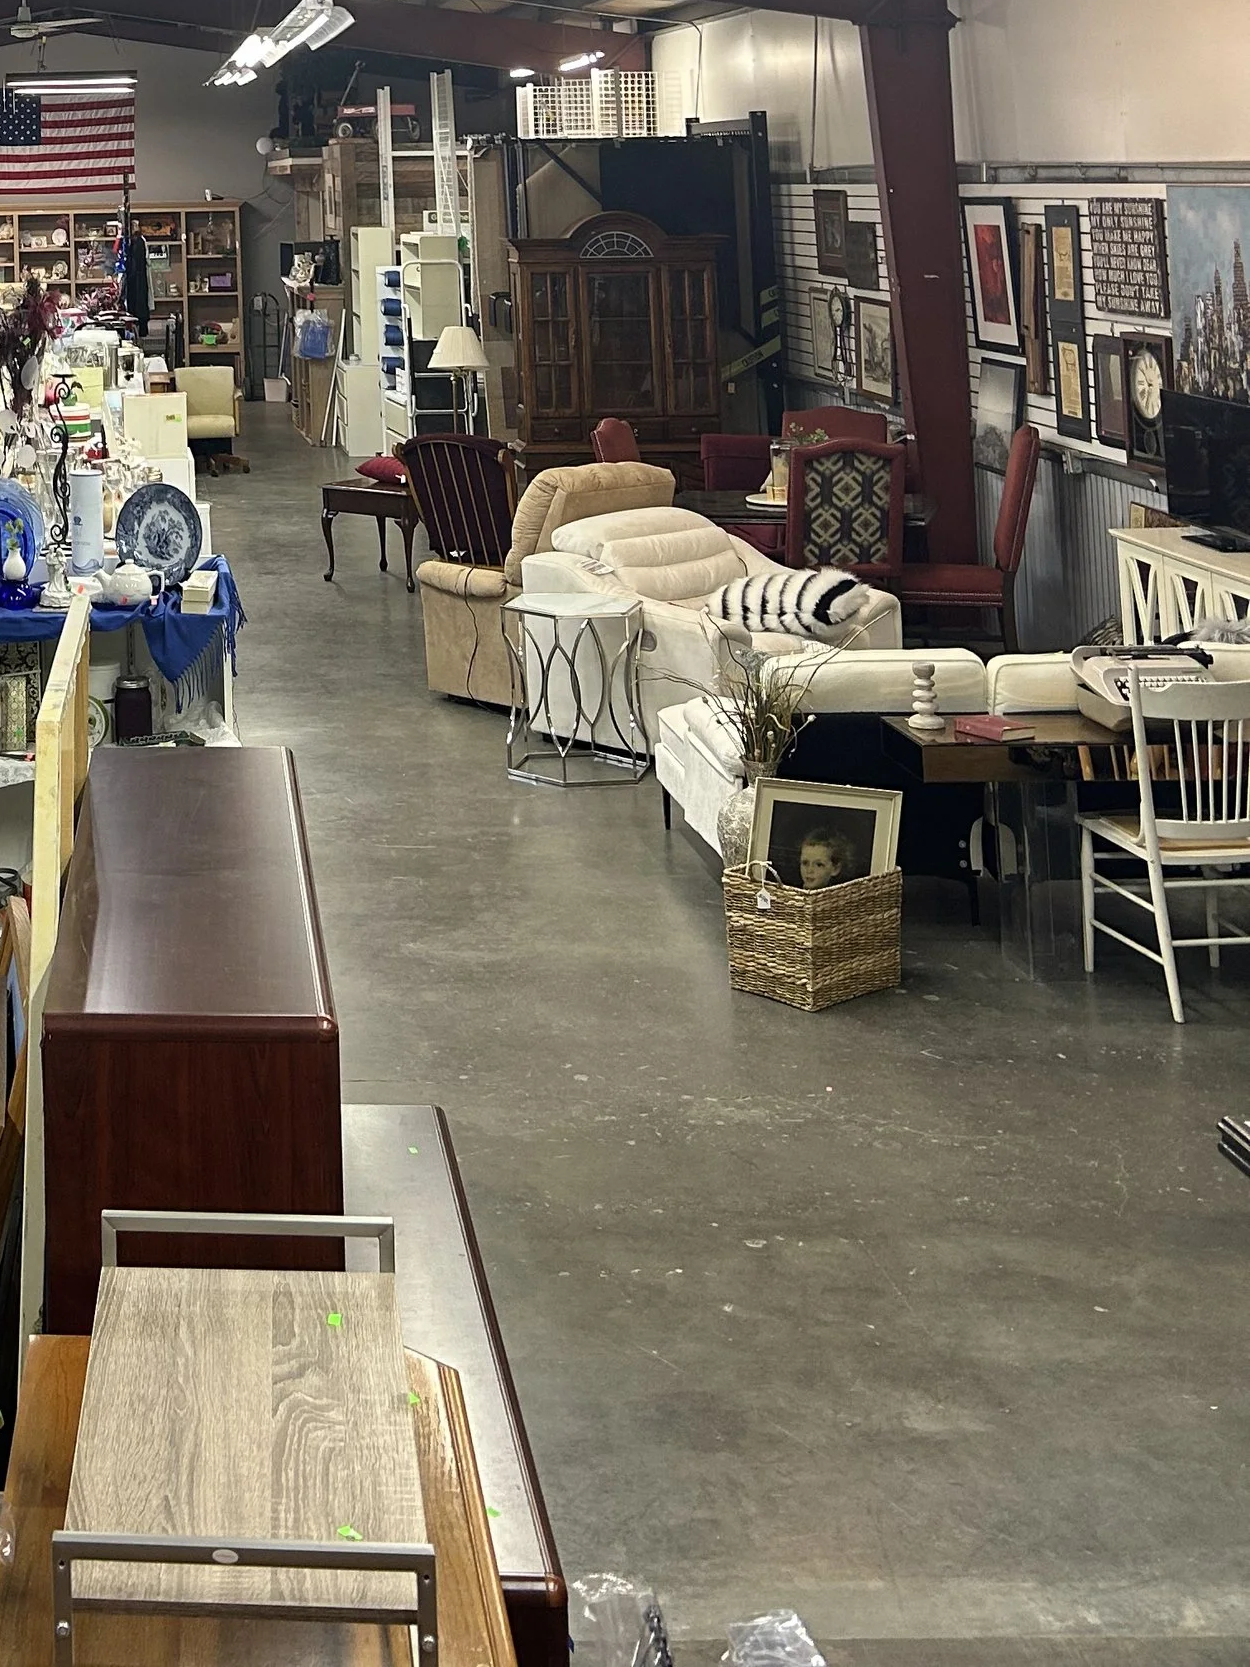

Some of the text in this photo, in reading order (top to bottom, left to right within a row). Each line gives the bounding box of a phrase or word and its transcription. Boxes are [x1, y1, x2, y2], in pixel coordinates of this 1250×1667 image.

[1102, 203, 1113, 214] ARE
[1114, 203, 1122, 214] MY
[1124, 203, 1152, 215] SUNSHINE
[1091, 216, 1152, 229] MY ONLY SUNSHINE
[1092, 229, 1154, 243] YOU MAKE ME HAPPY
[1093, 243, 1109, 254] WHEN
[1110, 243, 1126, 255] SKIES
[1127, 244, 1138, 256] ARE
[1110, 256, 1126, 269] NEVER
[1127, 257, 1142, 270] KNOW
[1094, 269, 1107, 281] HOW
[1108, 270, 1125, 283] MUCH
[1130, 272, 1145, 285] LOVE
[1146, 273, 1158, 286] YOU
[1095, 282, 1119, 295] PLEASE
[1141, 287, 1159, 299] TAKE
[1097, 295, 1160, 314] MY SUNSHINE AWAY
